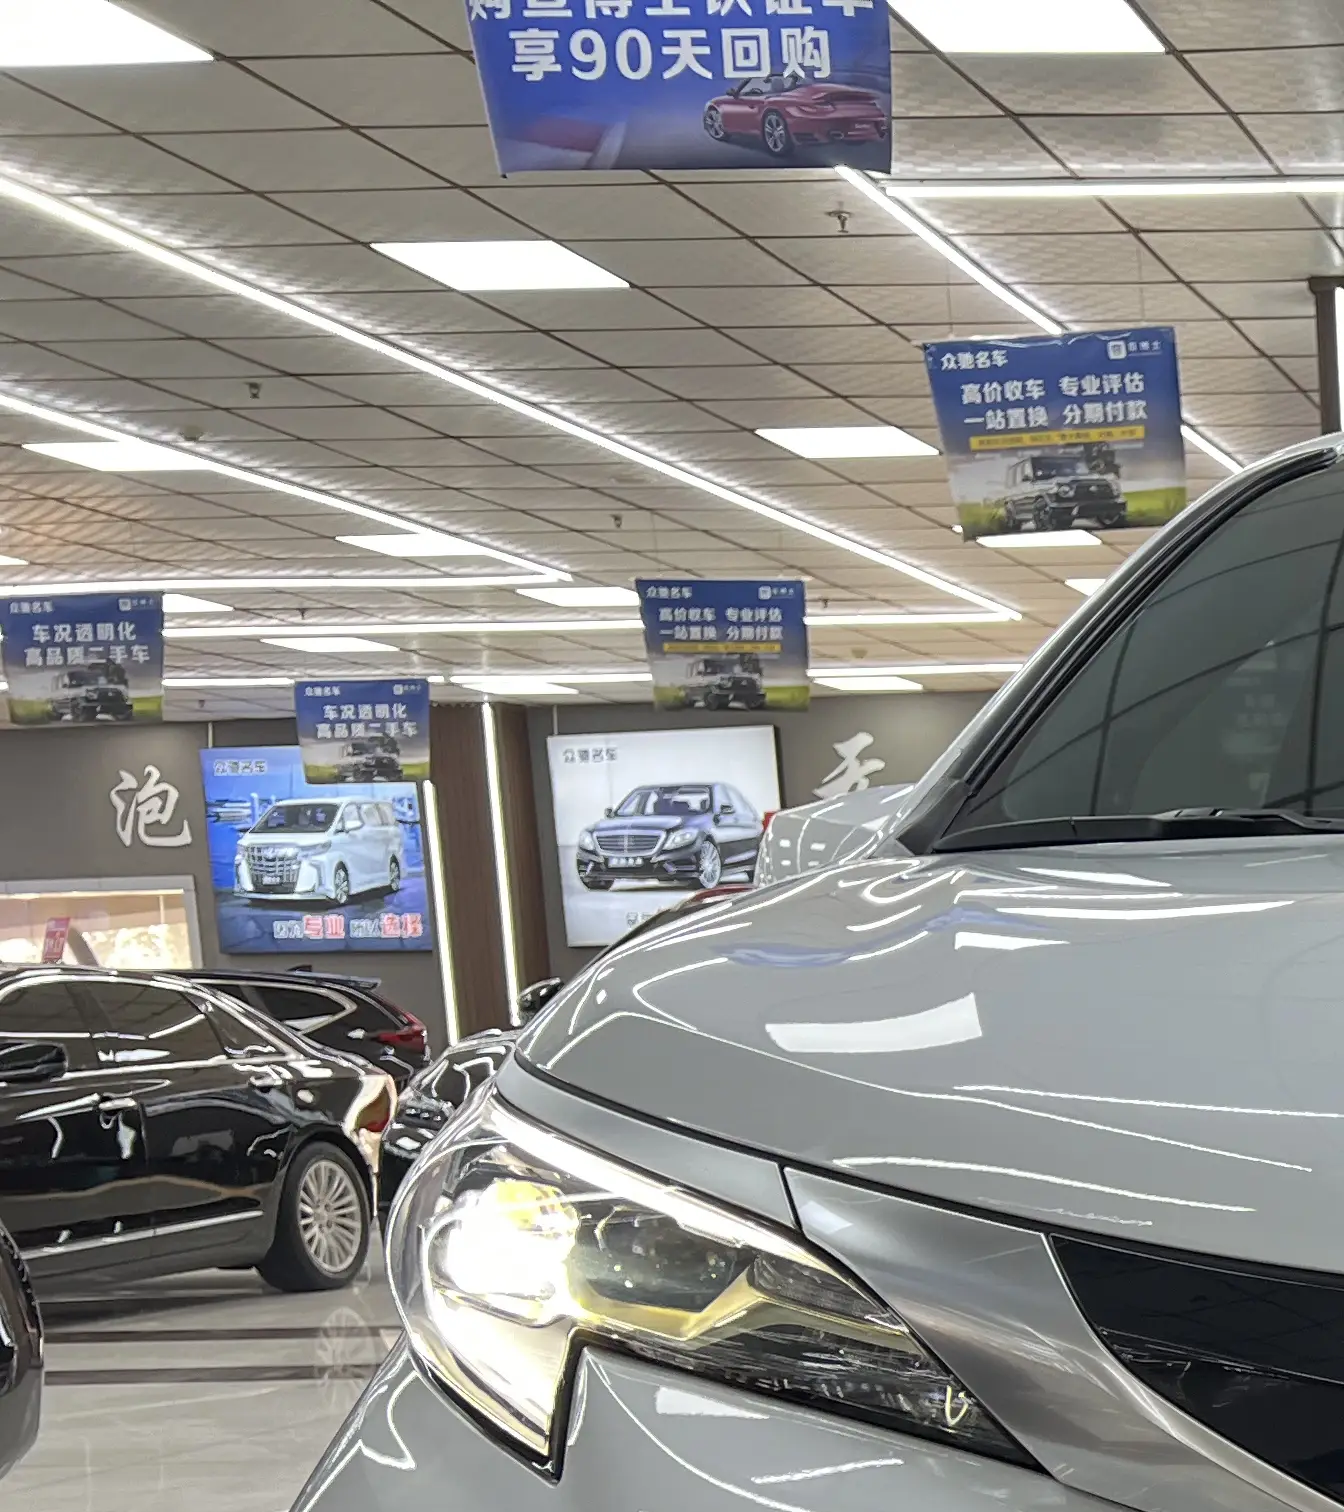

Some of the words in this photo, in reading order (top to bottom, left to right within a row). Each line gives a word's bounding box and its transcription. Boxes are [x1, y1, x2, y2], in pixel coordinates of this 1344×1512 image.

[508, 25, 832, 81] 享90天回购
[940, 350, 1009, 371] 众驰名车
[961, 379, 1046, 405] 高价收车
[1058, 372, 1145, 397] 专业评估
[963, 405, 1049, 431] 一站置换
[1063, 400, 1148, 425] 分期付款
[32, 621, 137, 643] 车况透明化
[24, 644, 150, 667] 高品质二手车
[322, 702, 408, 720] 车况透明化
[109, 764, 193, 847] 泡
